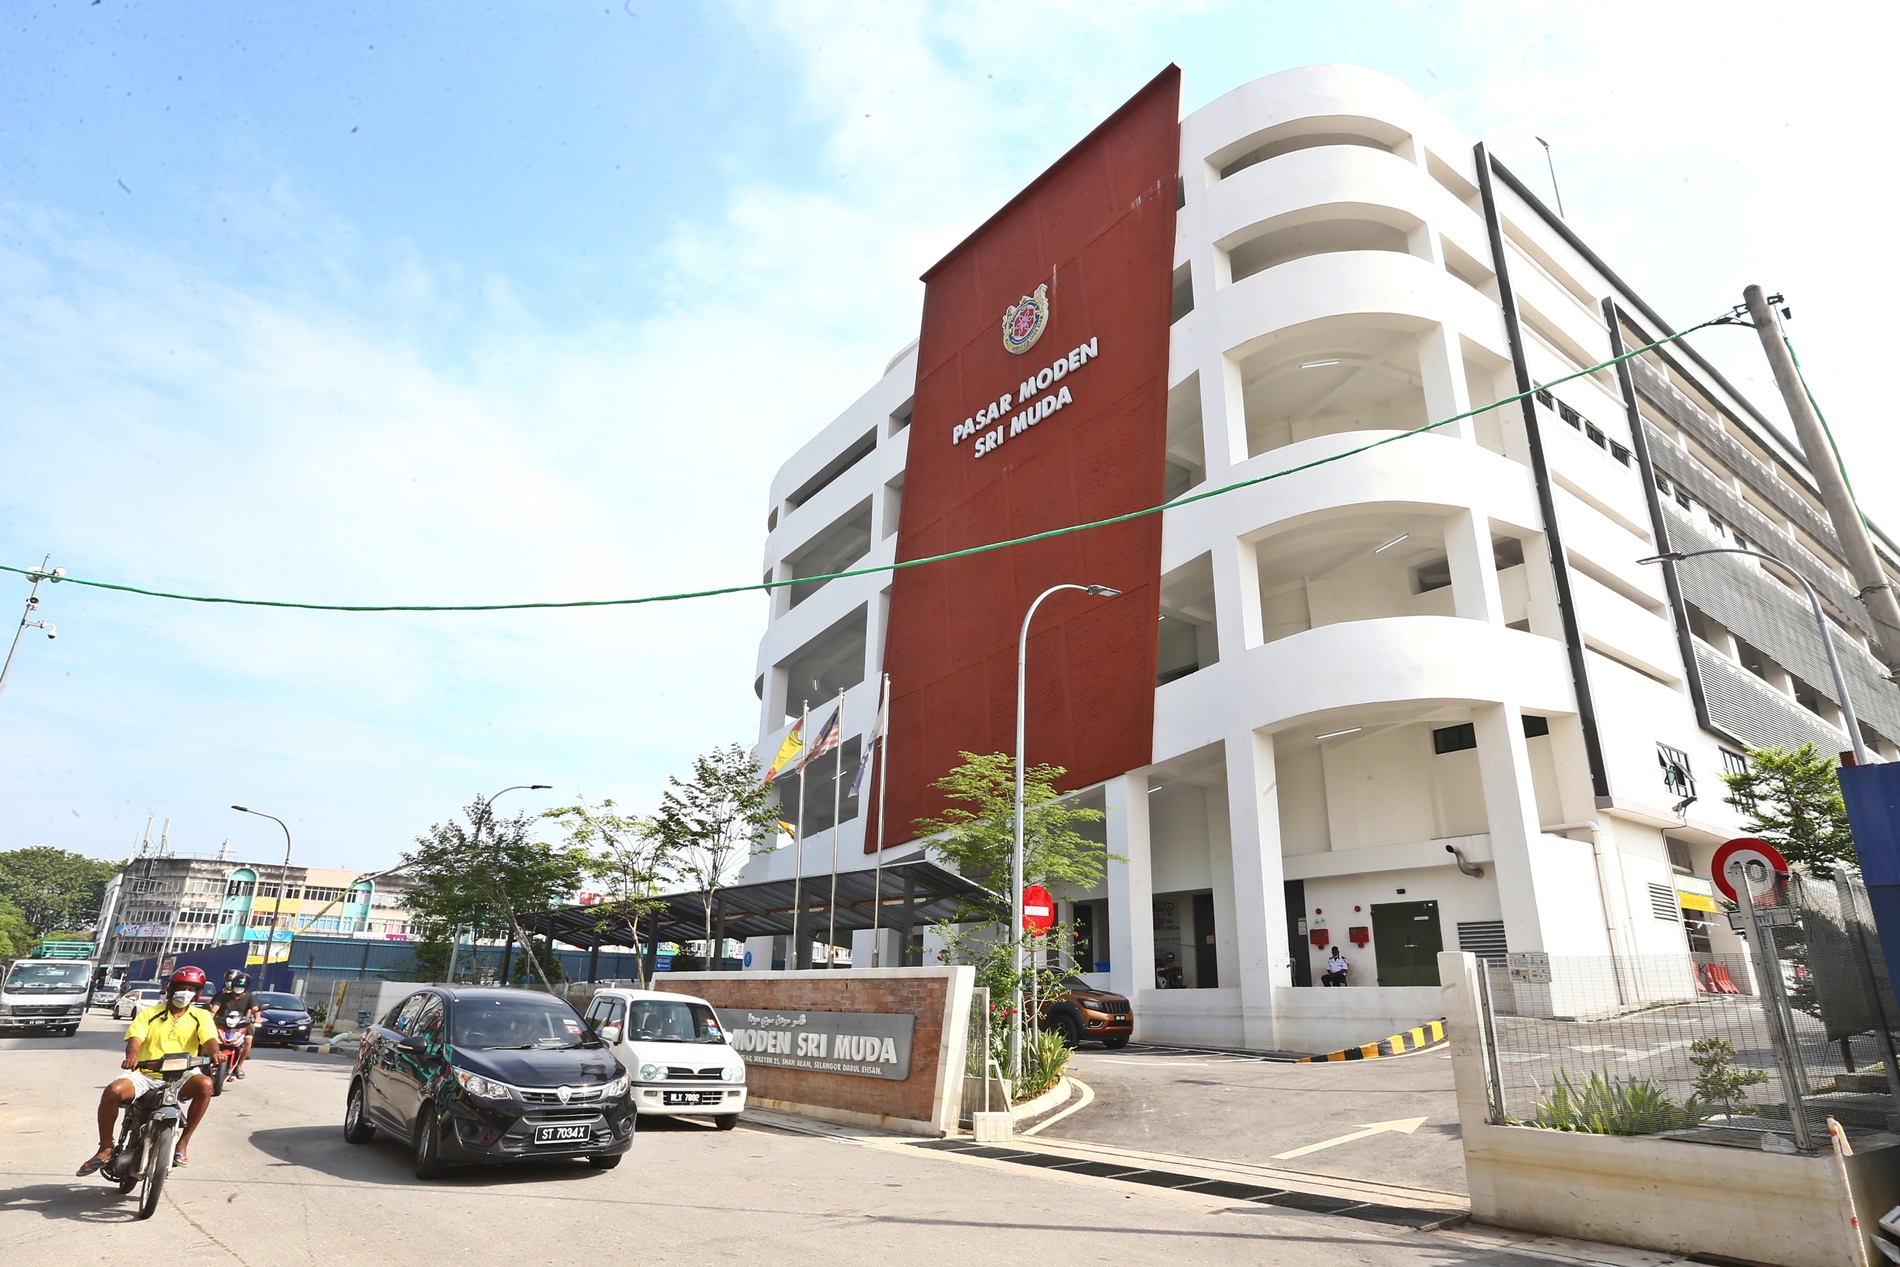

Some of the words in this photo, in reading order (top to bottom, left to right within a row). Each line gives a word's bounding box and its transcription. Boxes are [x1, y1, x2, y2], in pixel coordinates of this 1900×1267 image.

[952, 393, 1013, 445] PASAR
[1018, 336, 1099, 404] MODEN
[974, 425, 1004, 459] SRI
[1009, 385, 1073, 438] MUDA
[731, 1028, 792, 1054] MODEN
[797, 1032, 828, 1058] SRI
[833, 1034, 898, 1063] MUDA
[754, 1055, 773, 1064] SEKSYEN
[782, 1058, 796, 1066] SHAH
[796, 1059, 812, 1069] ALAM,
[813, 1061, 841, 1071] SELANGOR
[842, 1063, 861, 1073] DARUL
[861, 1065, 883, 1075] EHSAN.
[541, 1128, 555, 1140] ST
[556, 1126, 586, 1139] 7034X
